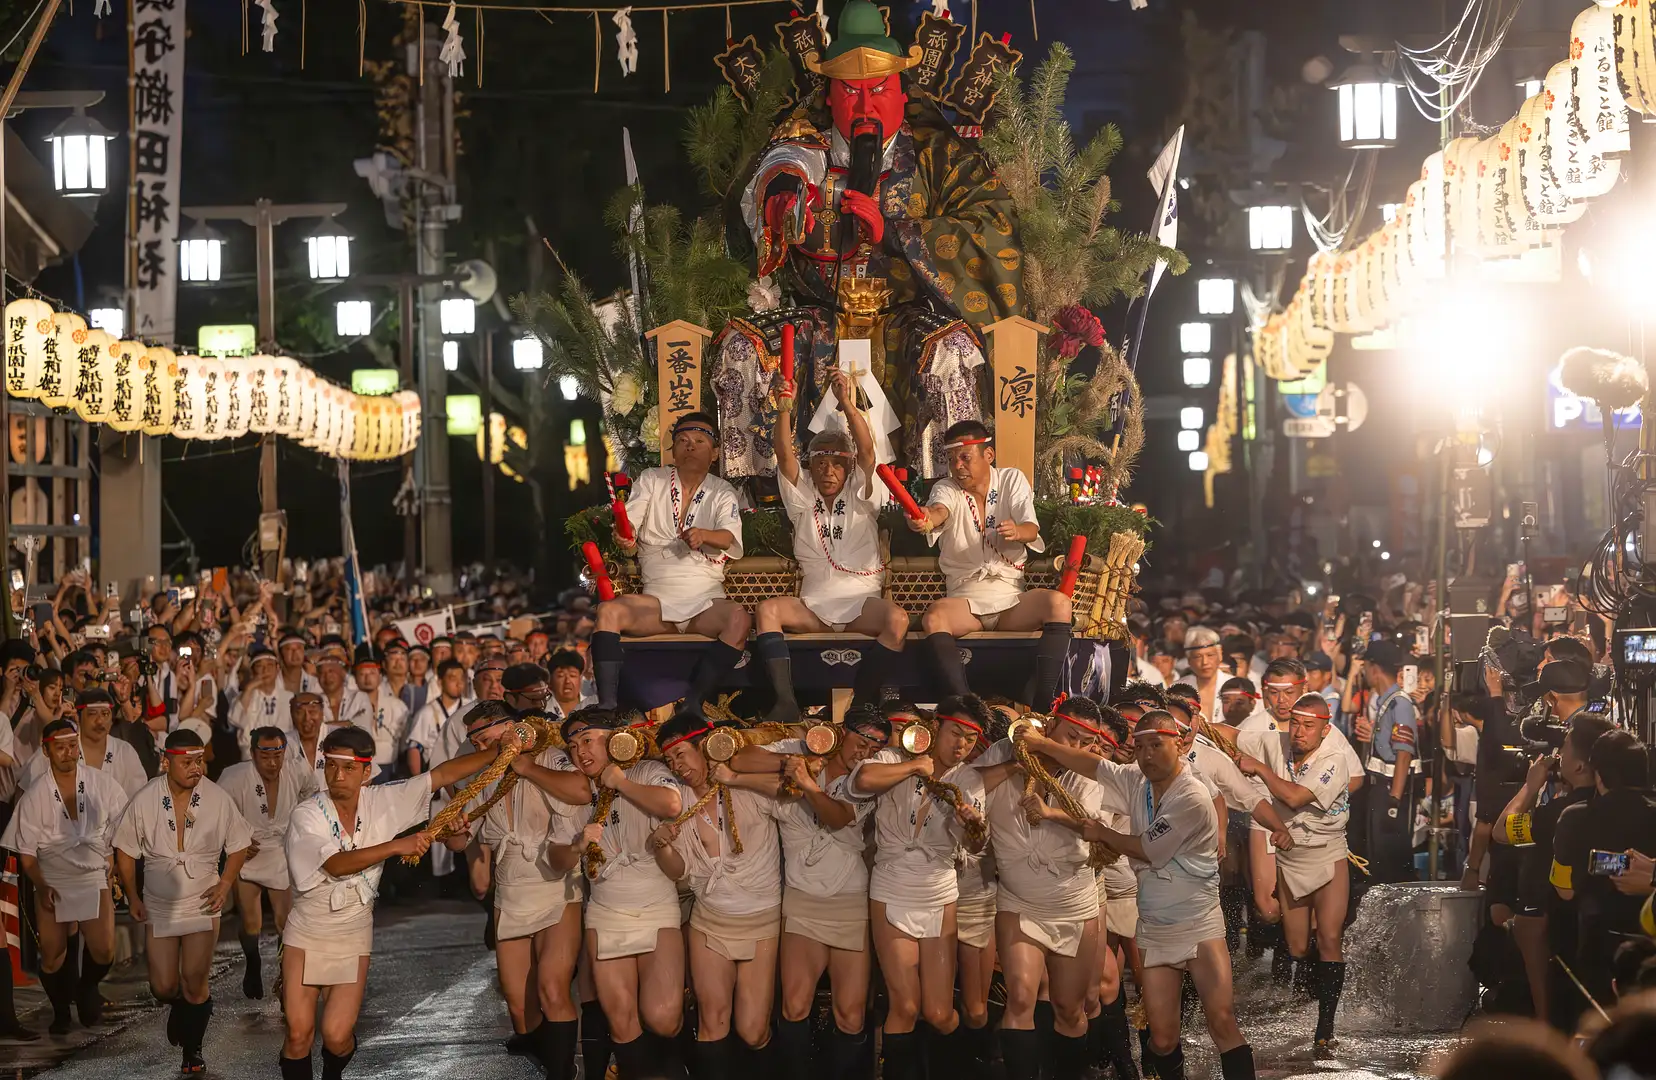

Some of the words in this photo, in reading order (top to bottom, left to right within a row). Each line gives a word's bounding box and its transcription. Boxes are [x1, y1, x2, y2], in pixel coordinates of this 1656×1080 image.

[734, 56, 761, 92] 大神
[917, 29, 948, 86] 祇園宮
[963, 53, 1002, 106] 大神宮
[8, 316, 28, 391] 博多祇園山笠
[666, 340, 697, 434] 一番山笠
[1554, 397, 1583, 427] P
[832, 499, 846, 540] 東流
